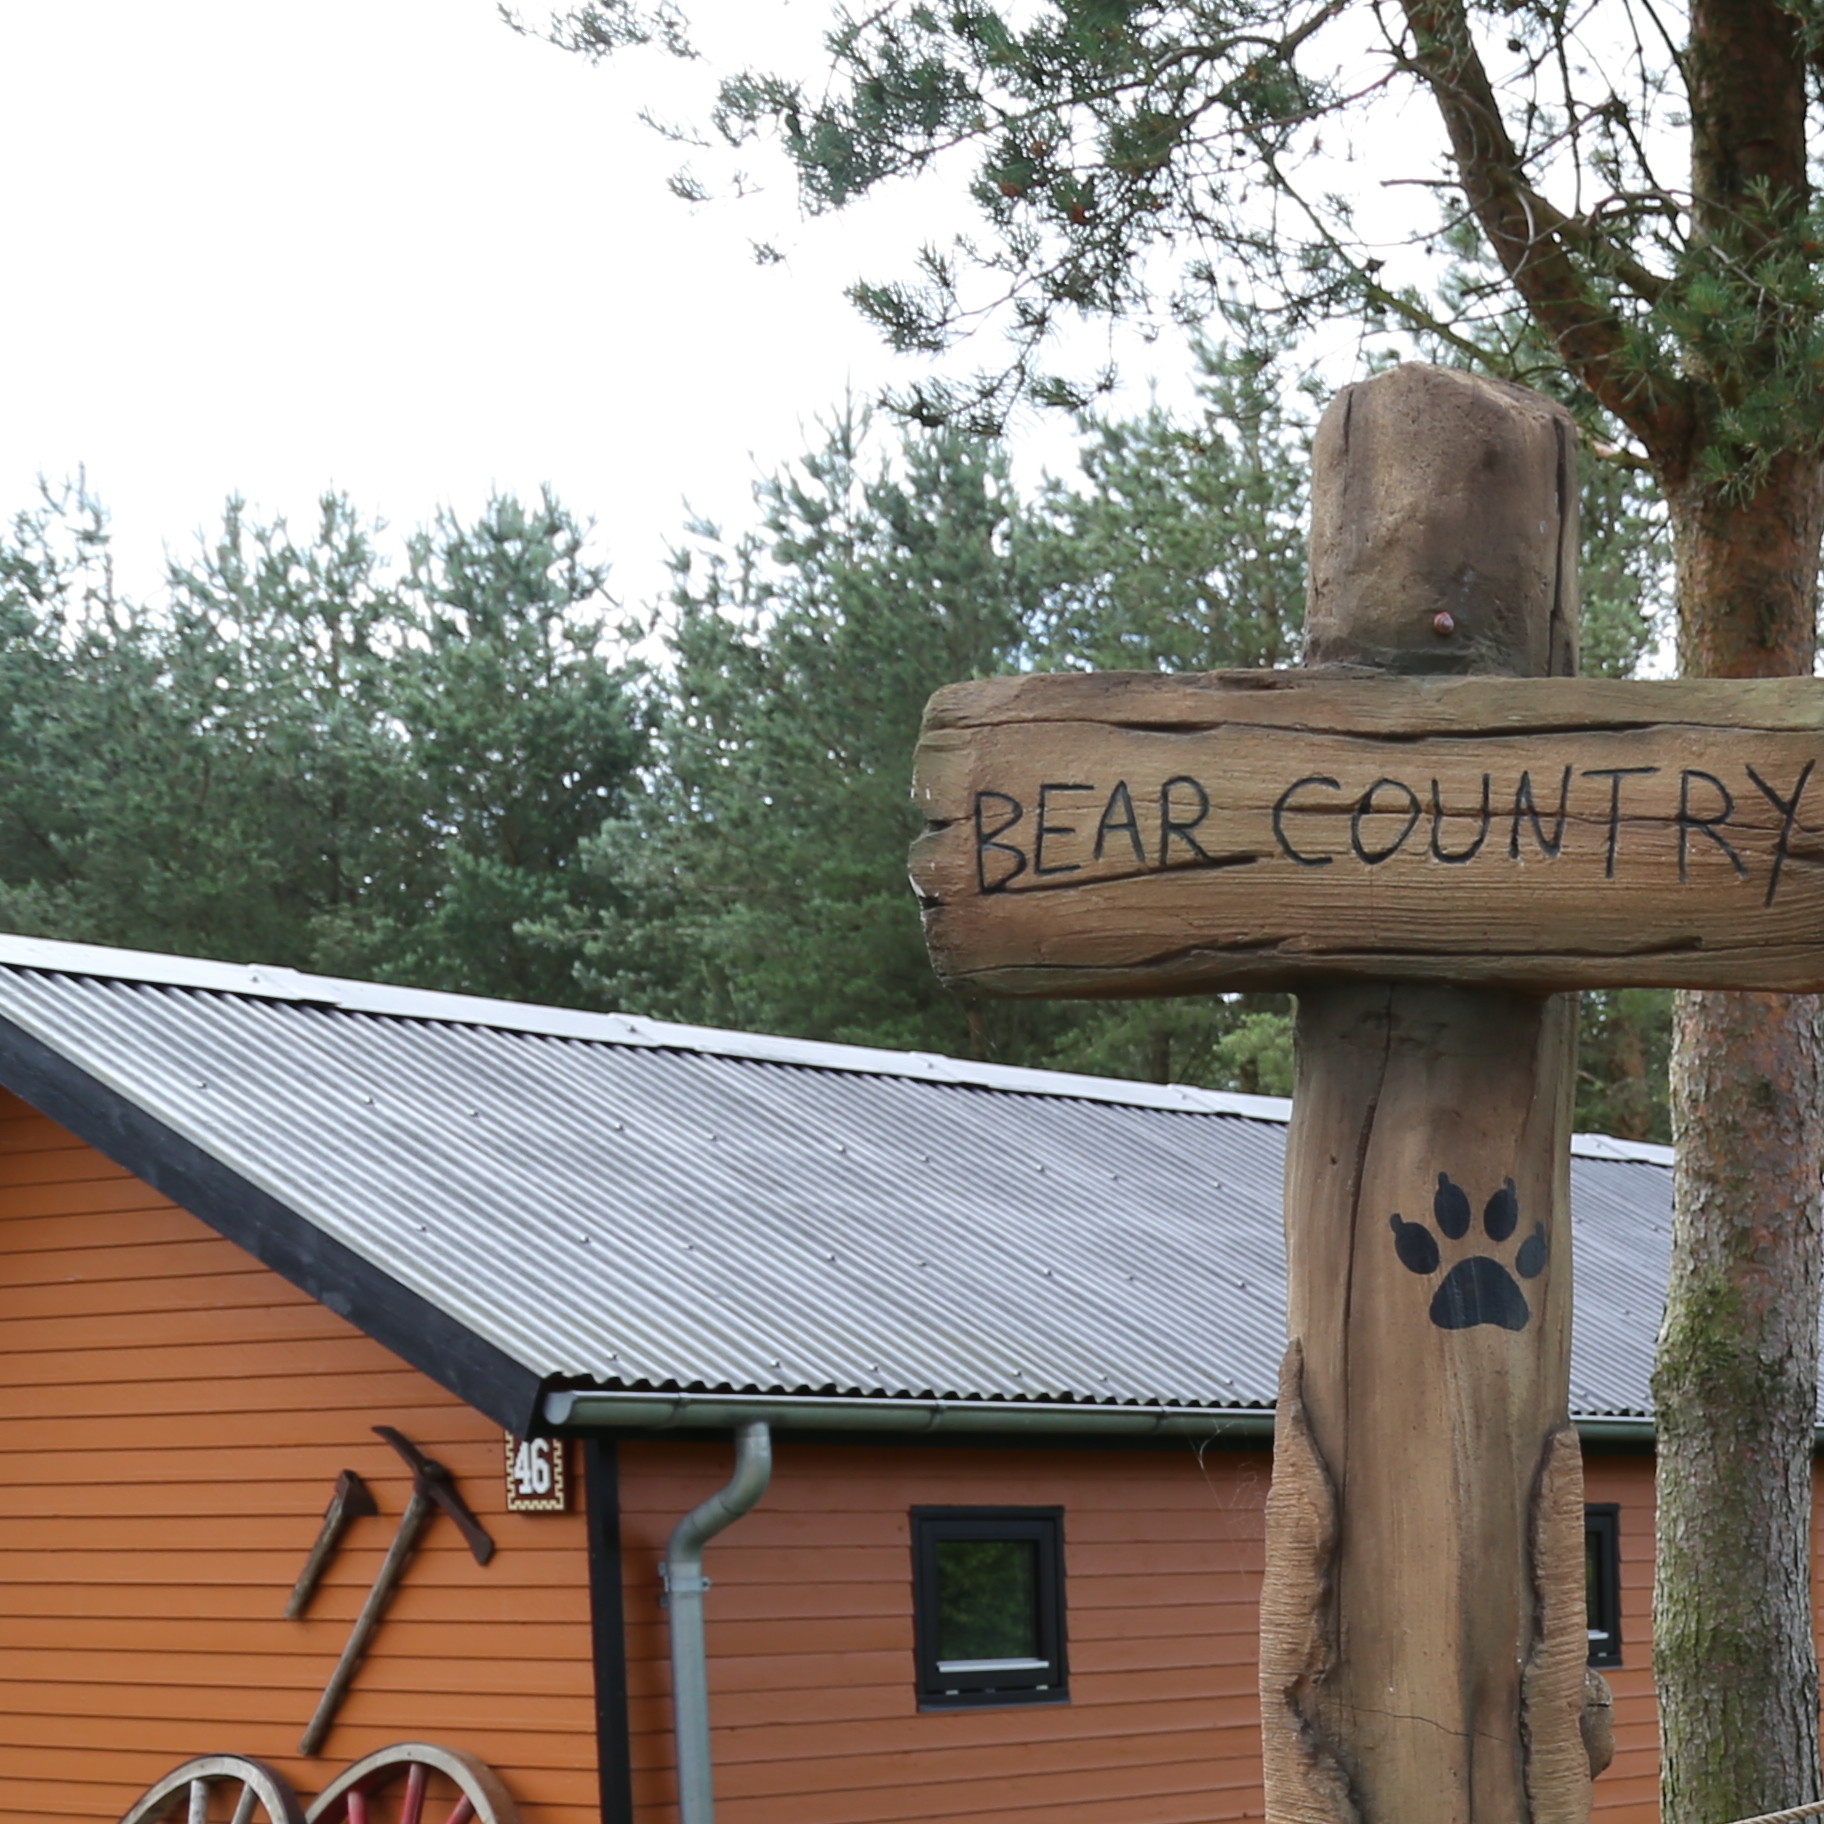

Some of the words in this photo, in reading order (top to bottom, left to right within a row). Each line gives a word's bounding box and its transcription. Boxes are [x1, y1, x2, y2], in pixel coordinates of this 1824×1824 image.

[974, 775, 1218, 894] BEAR
[1272, 758, 1816, 907] COUNTRY
[515, 1437, 550, 1494] 46
